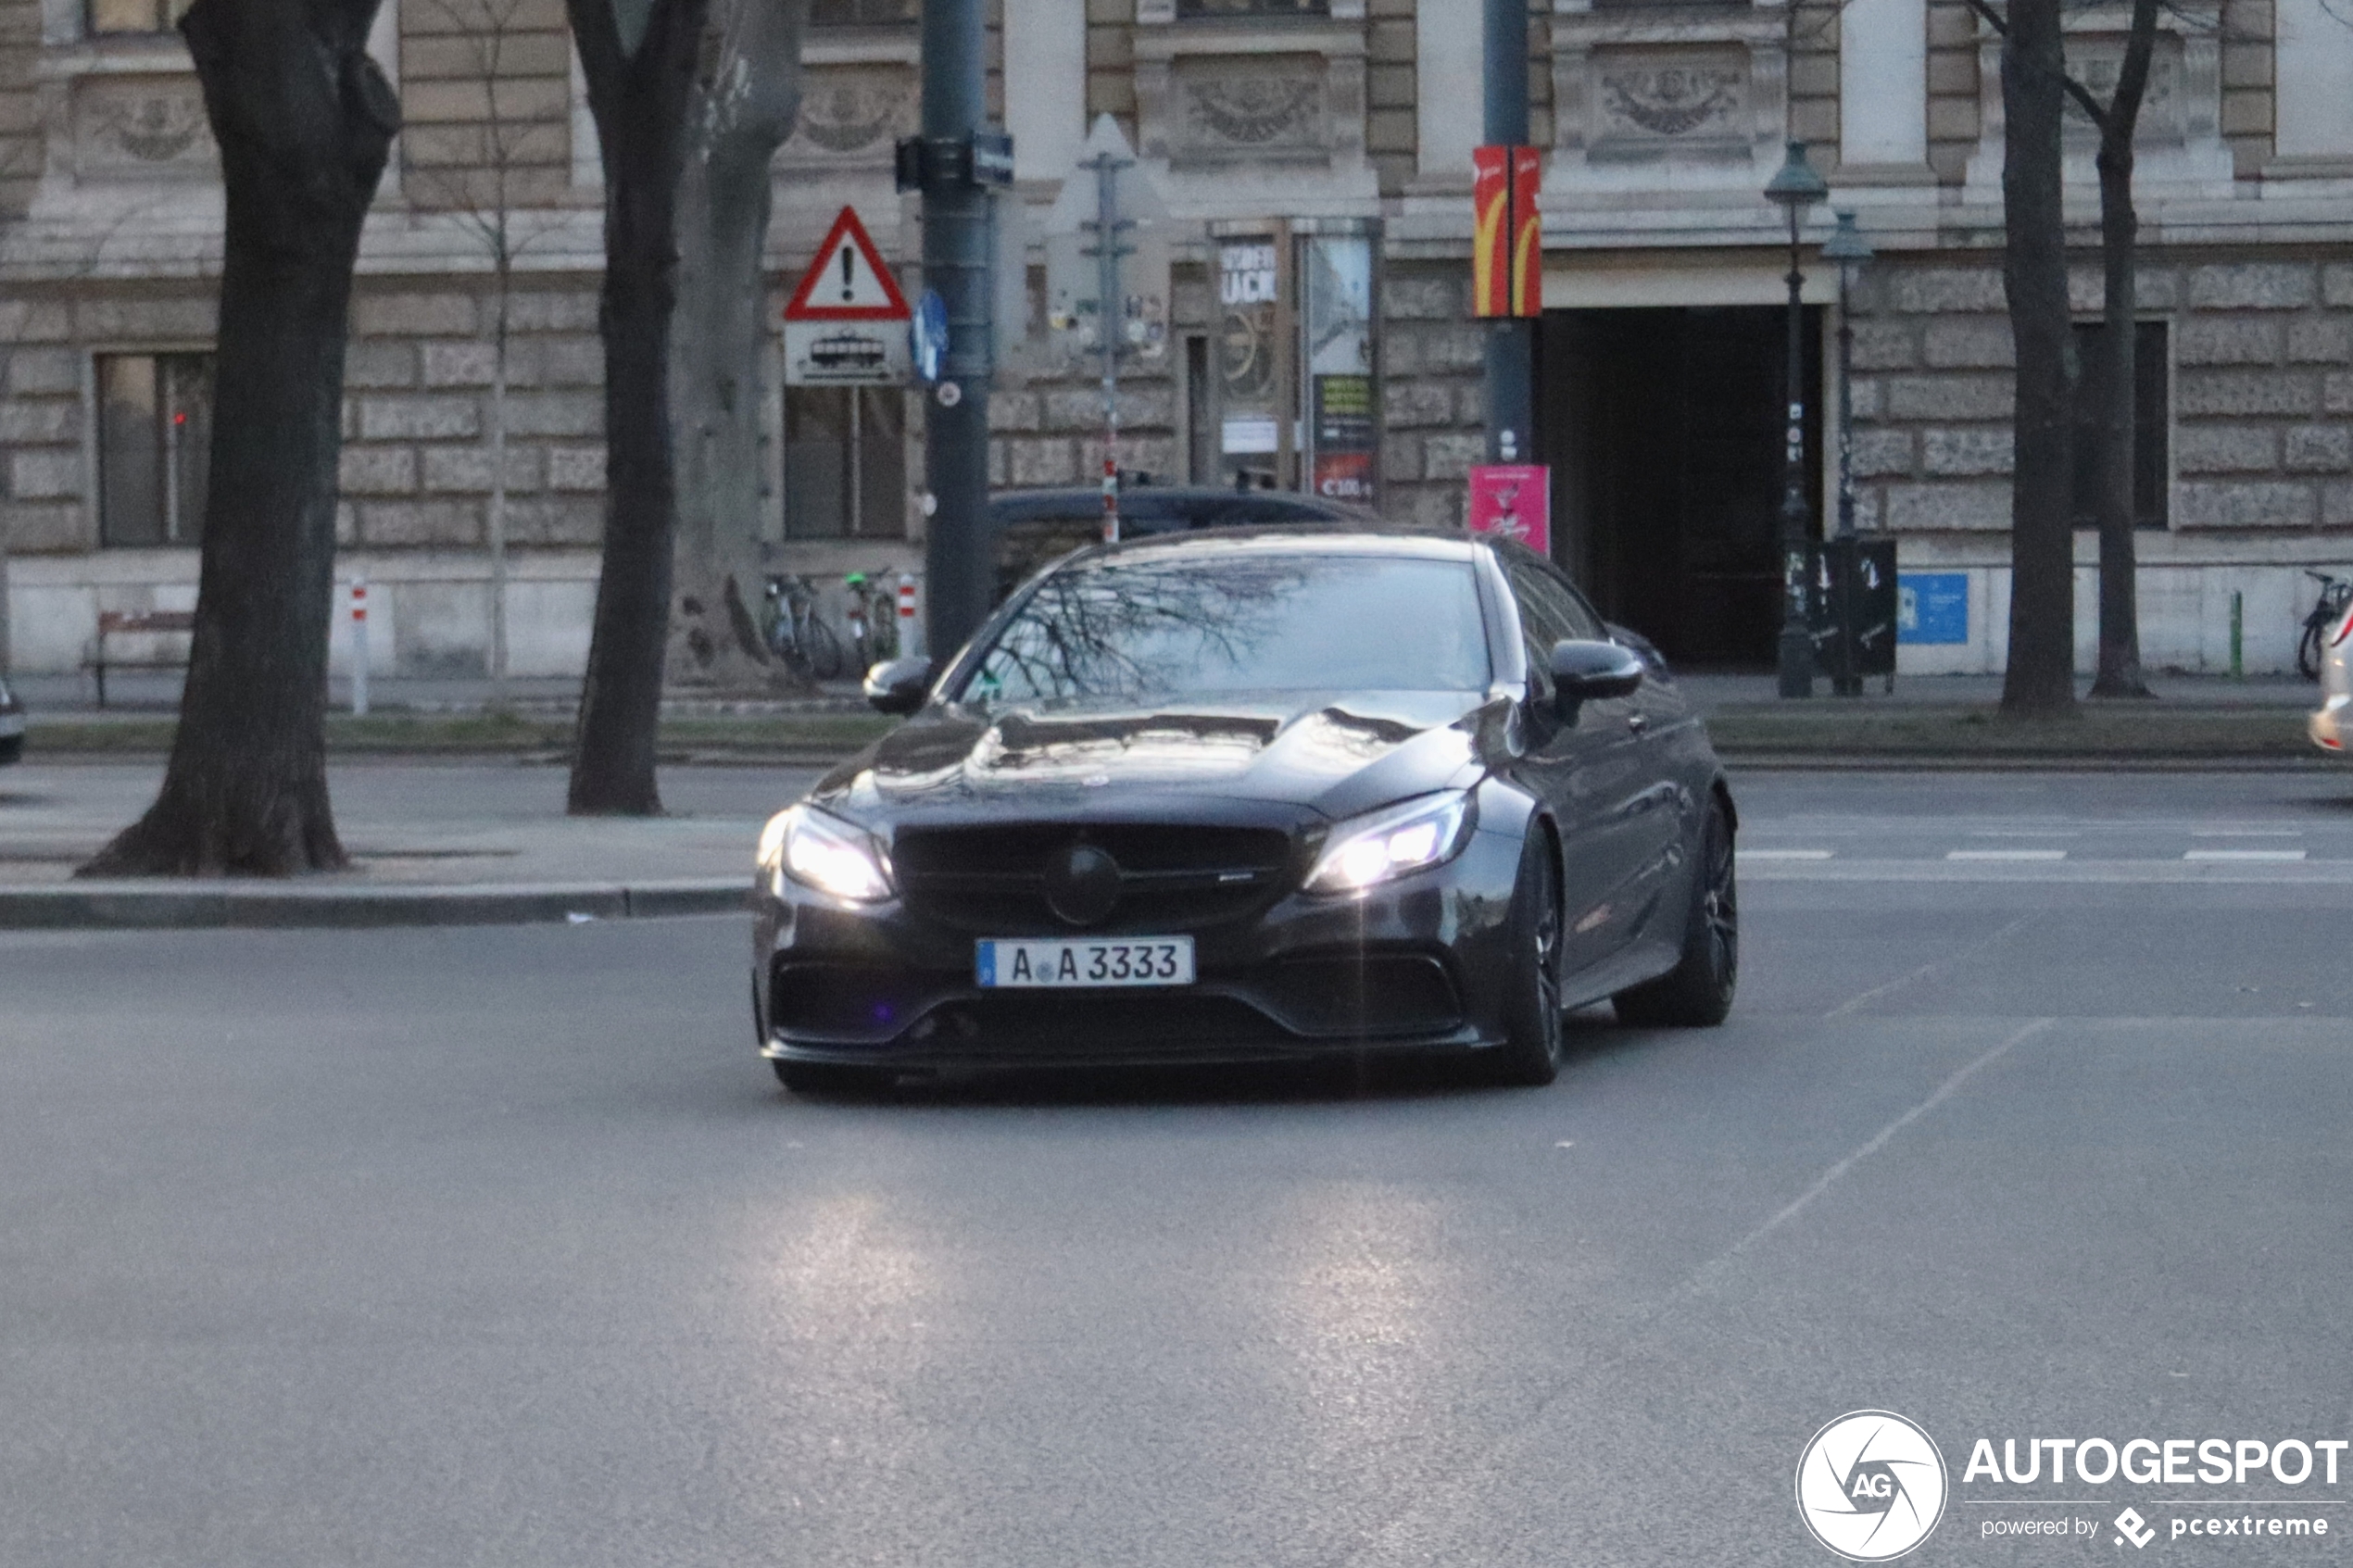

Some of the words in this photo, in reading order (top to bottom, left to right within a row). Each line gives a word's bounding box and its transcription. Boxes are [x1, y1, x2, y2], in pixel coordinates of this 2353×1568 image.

[1013, 947, 1033, 981] A
[1058, 947, 1078, 981] A
[1088, 945, 1177, 981] 3333
